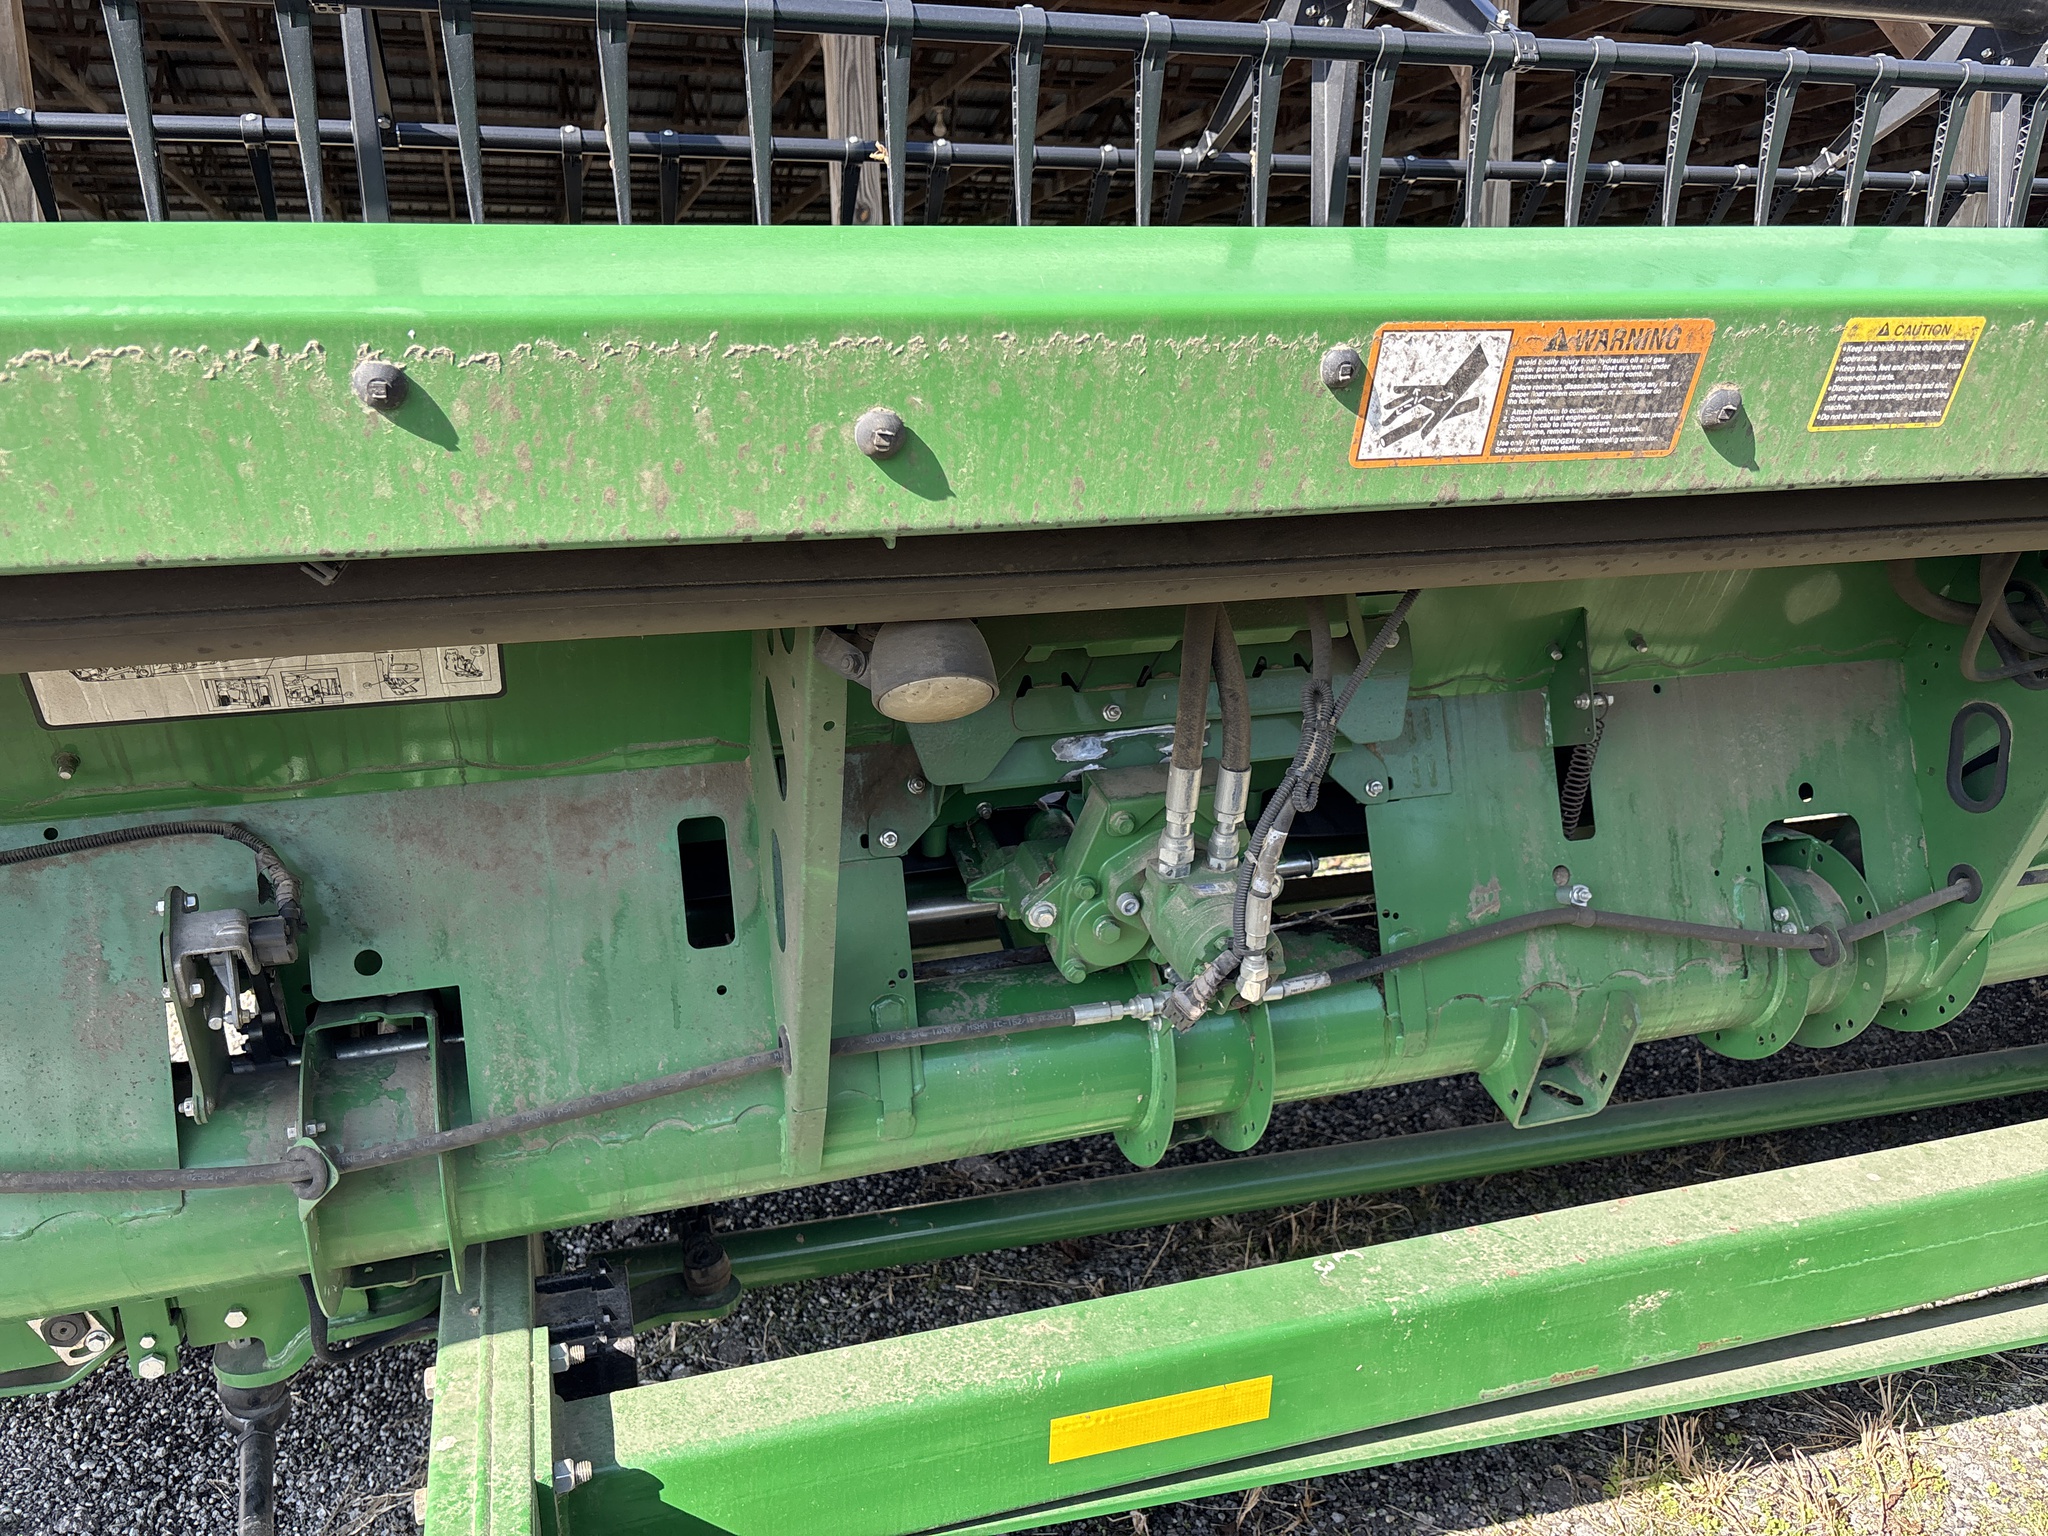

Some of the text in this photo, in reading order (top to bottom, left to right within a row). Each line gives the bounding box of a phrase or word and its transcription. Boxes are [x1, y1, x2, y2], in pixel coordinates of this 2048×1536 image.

[1894, 324, 1952, 336] CAUTION
[1573, 325, 1682, 351] WARNING
[1846, 344, 1862, 353] Keep
[1864, 344, 1873, 352] all
[1873, 344, 1895, 352] shields
[1904, 344, 1921, 352] place
[1922, 343, 1942, 352] during
[1943, 343, 1965, 351] normal
[1560, 358, 1579, 366] injury
[1598, 357, 1628, 365] hydraulic
[1839, 364, 1855, 373] Keep
[1856, 364, 1877, 372] hands,
[1930, 363, 1946, 371] away
[1947, 362, 1962, 370] from
[1835, 373, 1895, 383] power-driven parts.
[1865, 383, 1904, 391] power-driven
[1905, 383, 1921, 391] parts
[1934, 381, 1948, 389] shut
[1828, 393, 1837, 401] off
[1837, 393, 1858, 402] engine
[1859, 392, 1879, 401] before
[1880, 391, 1913, 401] unclogging
[1922, 391, 1949, 400] servicing
[1824, 402, 1851, 411] machine.
[1820, 412, 1831, 421] Do
[1842, 412, 1857, 420] leave
[1858, 411, 1882, 420] running
[1582, 420, 1611, 428] pressure.
[1586, 436, 1618, 444] recharging
